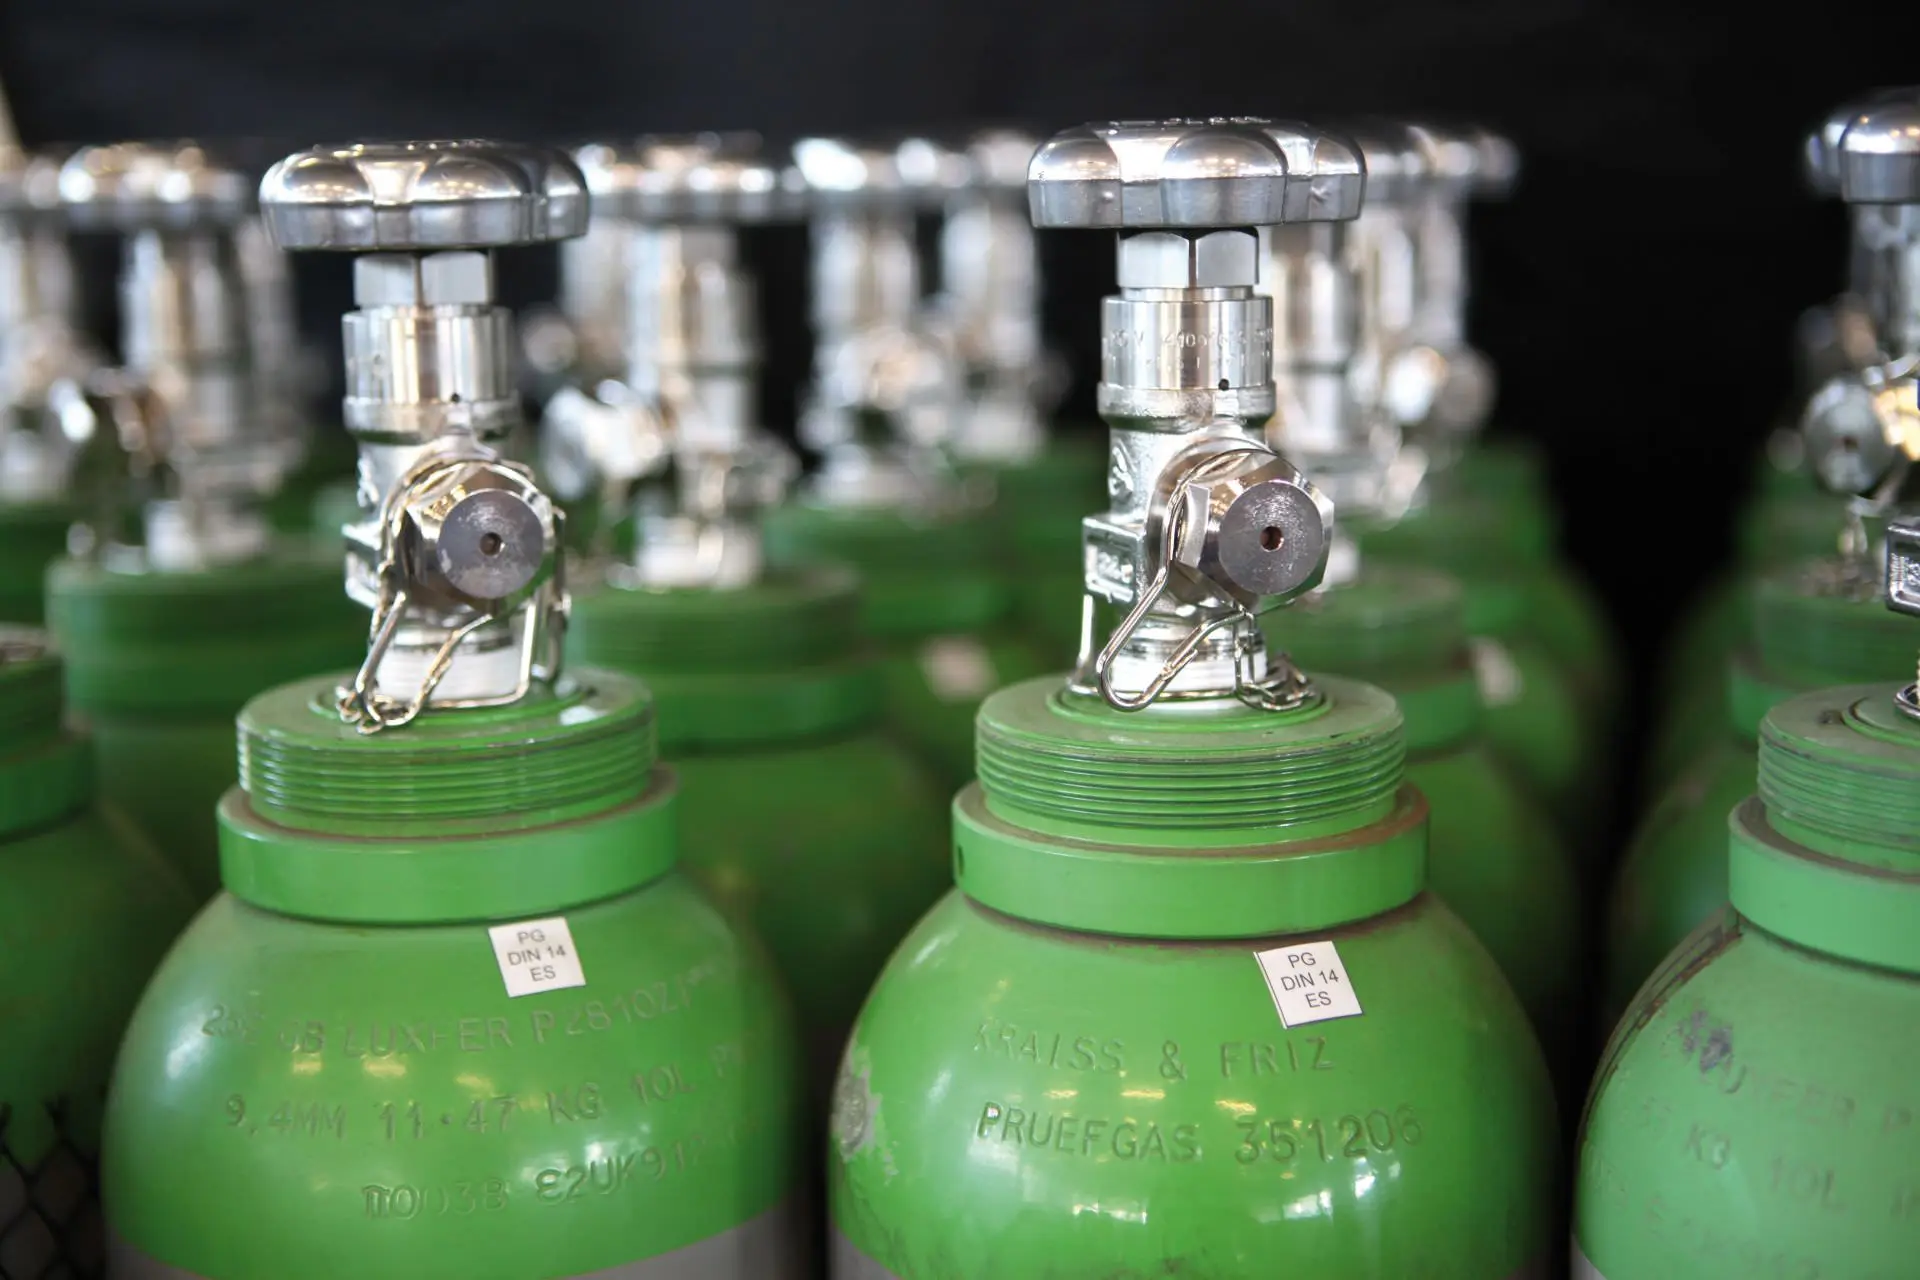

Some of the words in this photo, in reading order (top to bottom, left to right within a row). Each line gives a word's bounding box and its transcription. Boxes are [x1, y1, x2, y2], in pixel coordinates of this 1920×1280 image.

[517, 928, 546, 944] PG
[507, 950, 541, 966] DIN
[548, 945, 566, 958] 14
[1287, 952, 1316, 968] PG
[530, 965, 556, 982] ES
[1280, 971, 1315, 991] DIN
[1319, 969, 1339, 985] 14
[1305, 991, 1332, 1008] ES
[974, 1019, 1123, 1073] KRAISS
[1159, 1041, 1187, 1081] &
[1220, 1036, 1337, 1079] FRIZ
[975, 1101, 1200, 1165] PRUEFGAS
[1234, 1103, 1424, 1165] 351206
